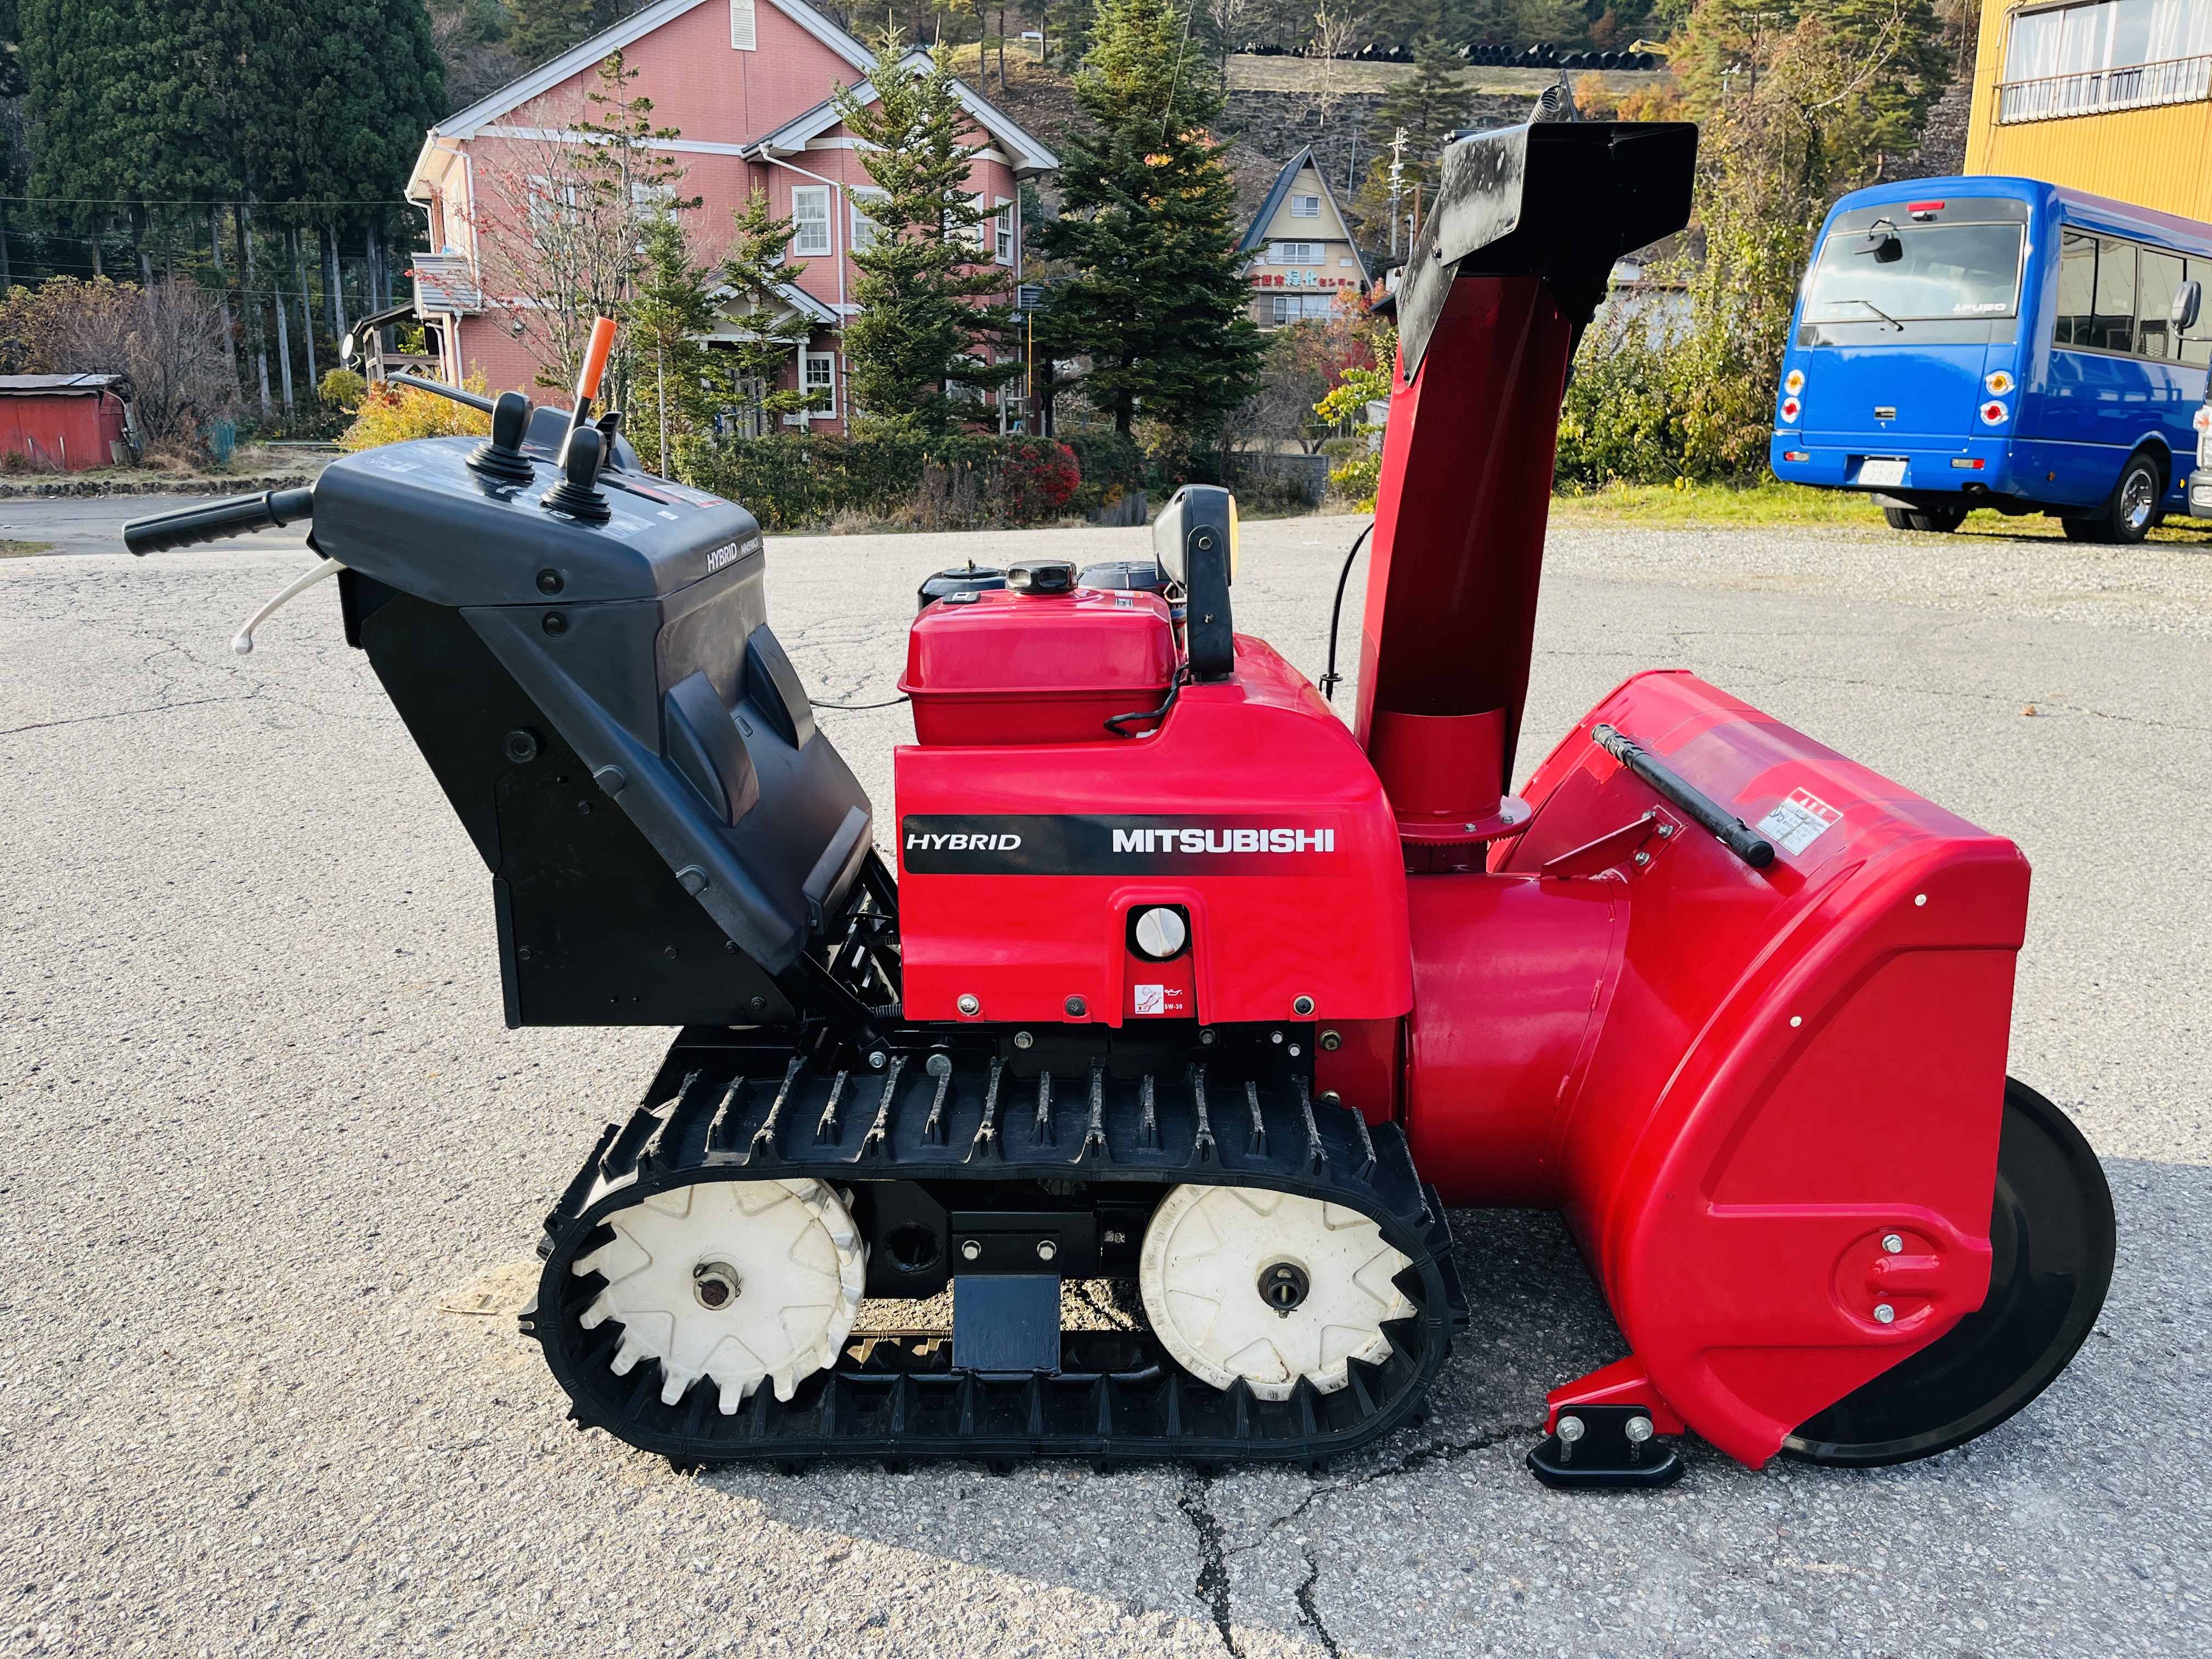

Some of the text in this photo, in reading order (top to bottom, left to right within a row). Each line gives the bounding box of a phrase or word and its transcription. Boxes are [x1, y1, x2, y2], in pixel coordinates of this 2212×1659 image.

[1962, 303, 2007, 312] FUSO
[707, 542, 737, 572] HYBRID
[906, 828, 1335, 853] HYBRID MITSUBISHI
